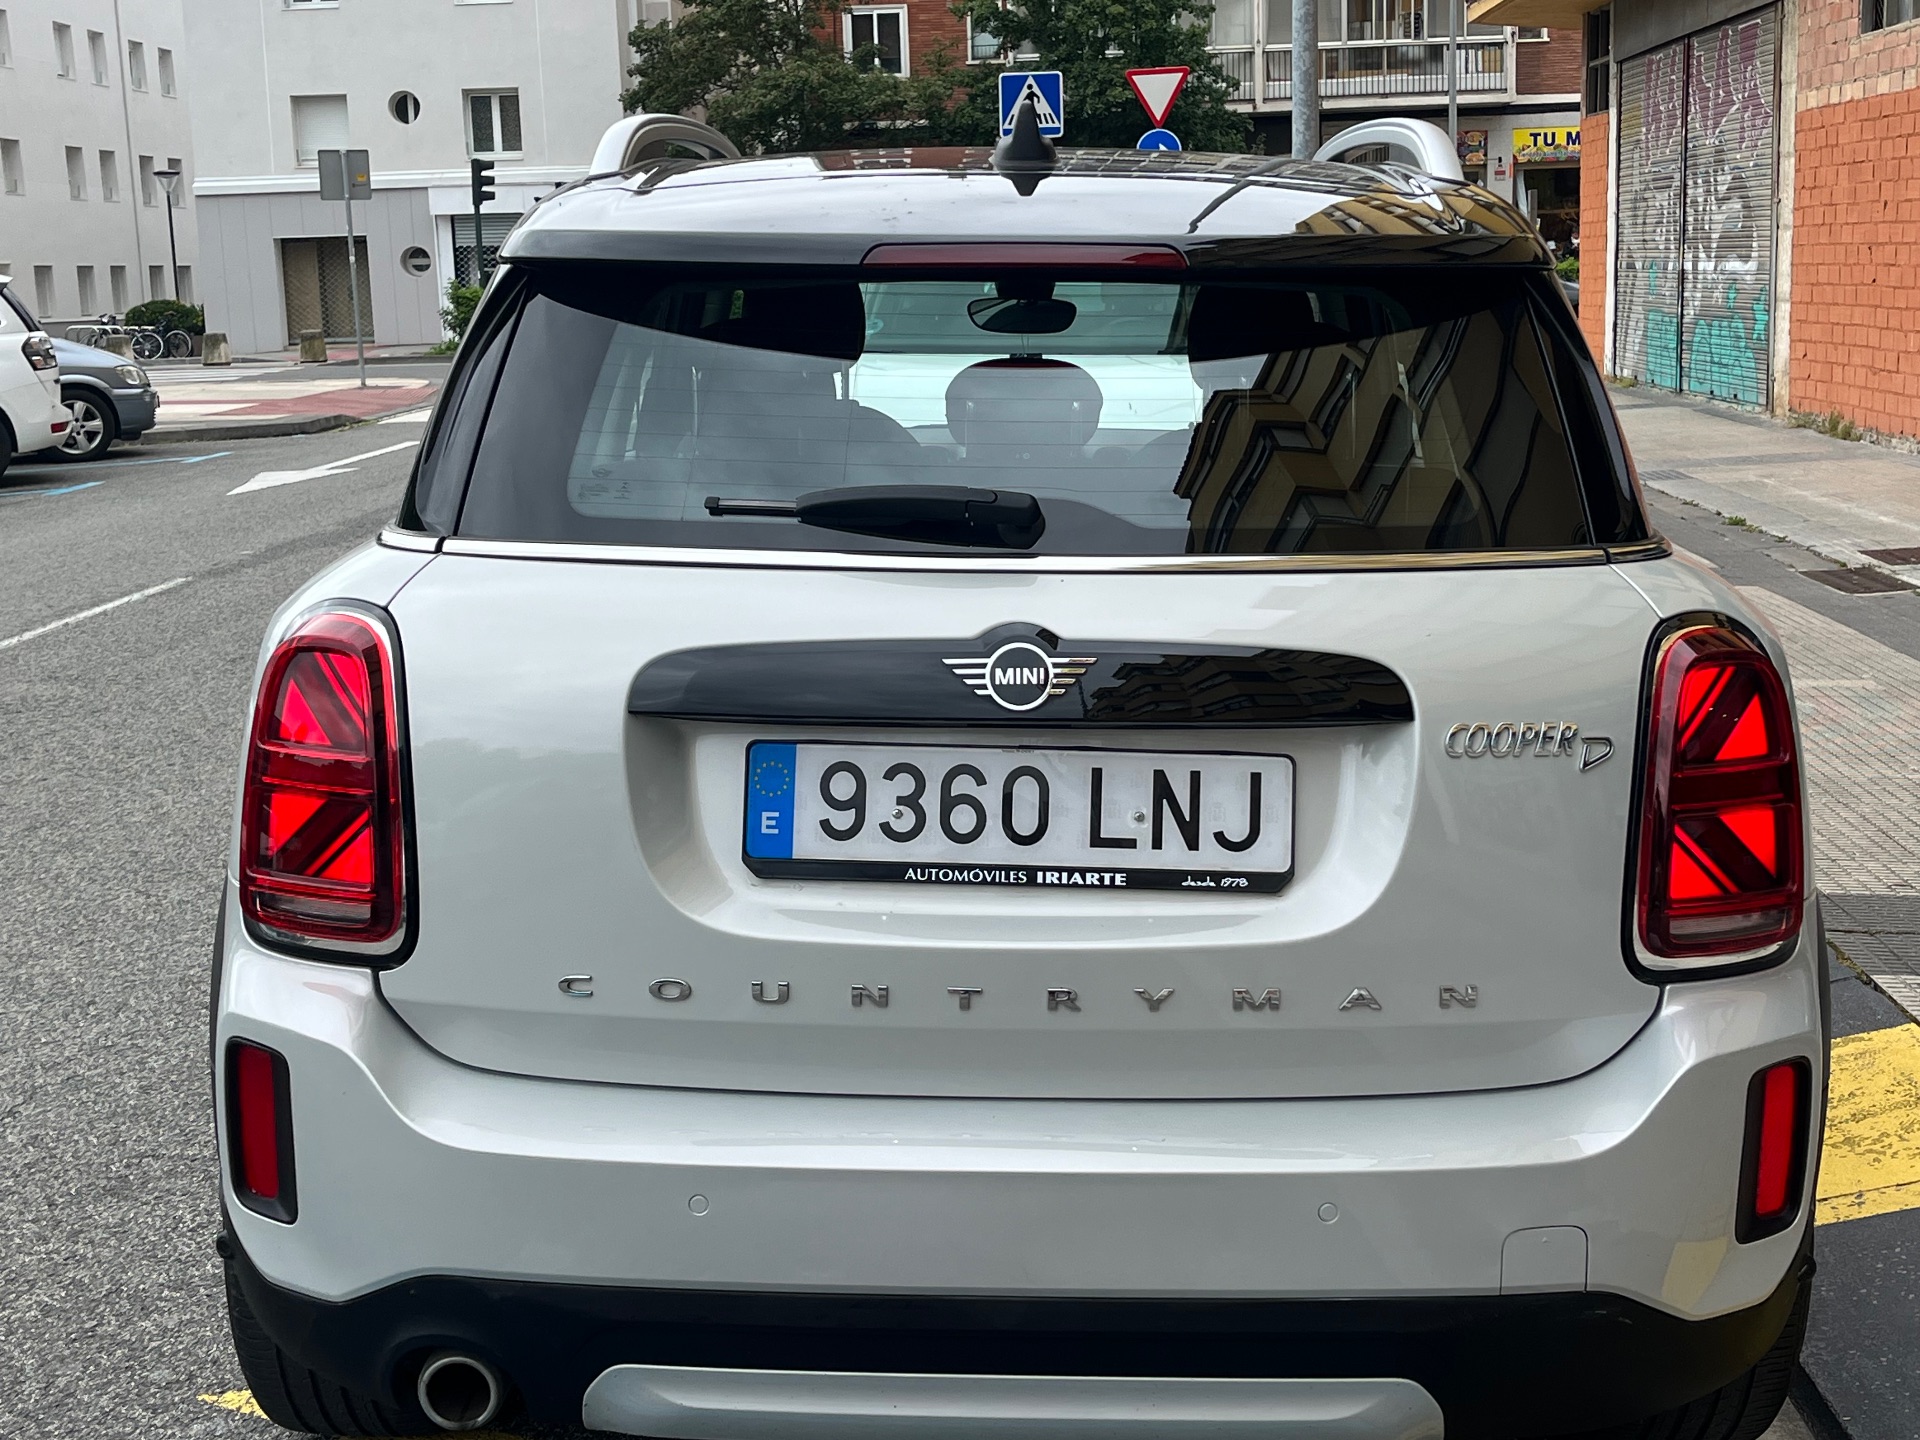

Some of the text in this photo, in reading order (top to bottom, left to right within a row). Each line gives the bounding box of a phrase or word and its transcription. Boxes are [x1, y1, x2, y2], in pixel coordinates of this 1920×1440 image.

[1529, 131, 1556, 147] TU
[994, 667, 1046, 685] MINI
[1445, 721, 1615, 773] COOPER D
[818, 760, 1262, 852] 9360 LNJ
[760, 812, 780, 835] E
[904, 867, 1027, 883] AUTOMÓVILES
[1036, 871, 1127, 886] IRIARTE
[1220, 877, 1249, 887] 1978
[556, 972, 1479, 1012] COUNTRYMAN
